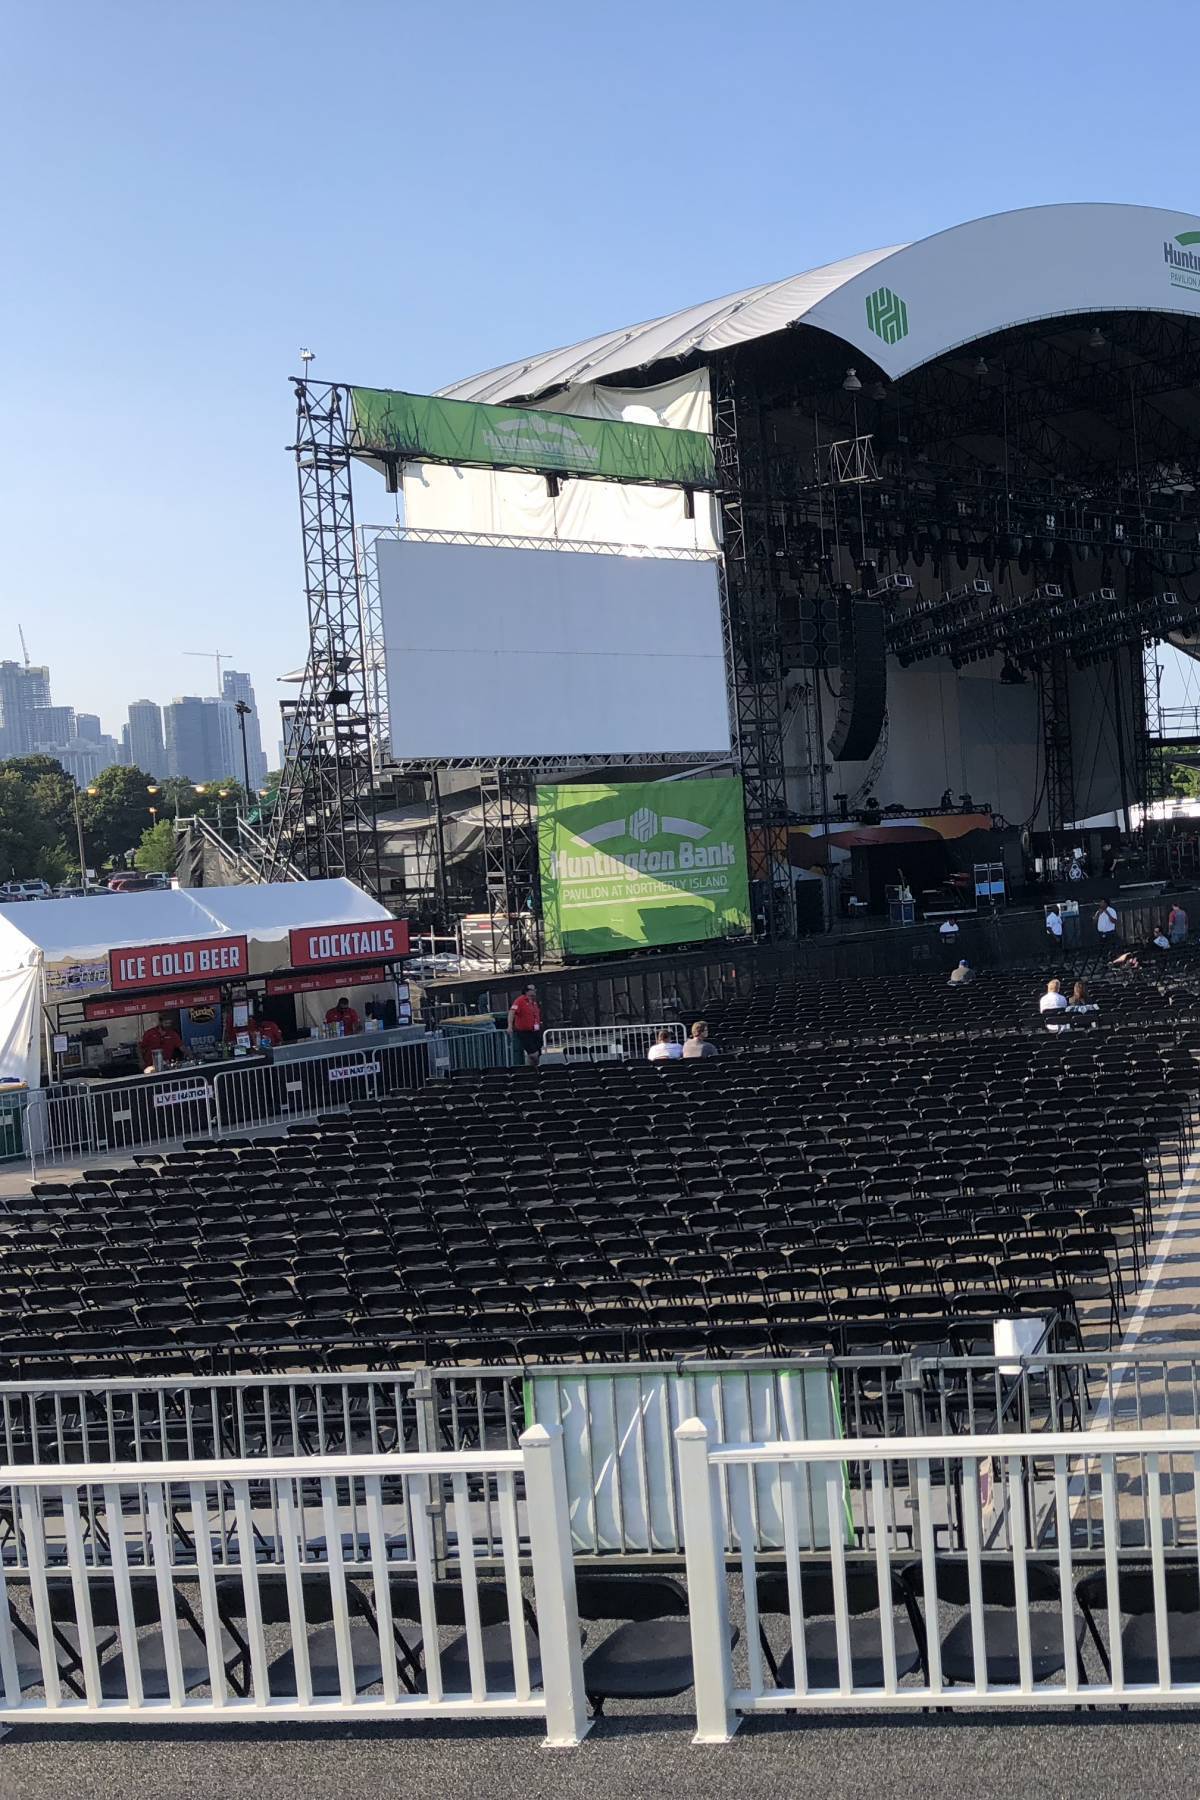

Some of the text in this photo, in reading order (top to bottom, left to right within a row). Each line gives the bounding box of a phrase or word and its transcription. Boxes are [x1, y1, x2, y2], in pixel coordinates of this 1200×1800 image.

[1170, 272, 1198, 286] PAVILION
[551, 841, 736, 881] Huntington Bank
[563, 875, 728, 900] PAVILION AT NORTHERLY ISLAND
[309, 929, 395, 960] COCKTAILS
[120, 956, 147, 981] ICE
[152, 951, 195, 977] COLD
[200, 946, 240, 971] BEER
[331, 1068, 349, 1079] LIVE
[156, 1093, 177, 1104] LIVE
